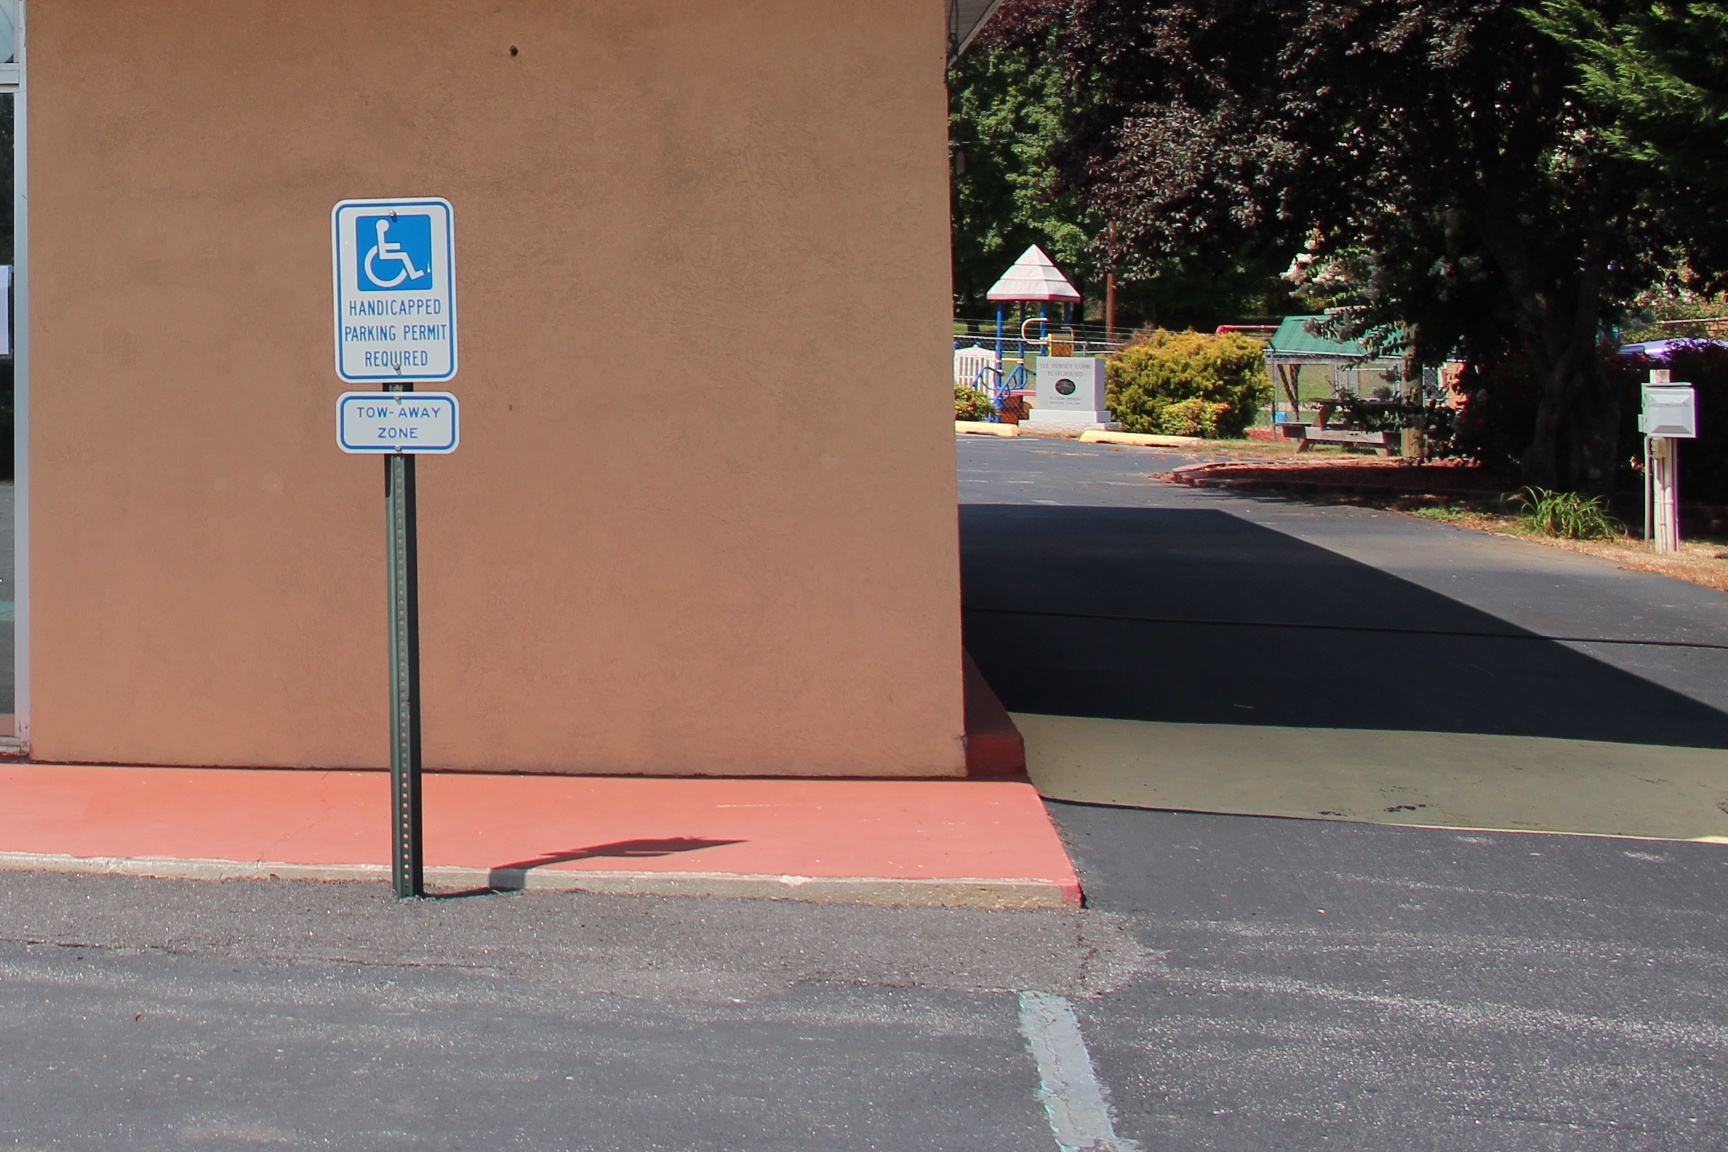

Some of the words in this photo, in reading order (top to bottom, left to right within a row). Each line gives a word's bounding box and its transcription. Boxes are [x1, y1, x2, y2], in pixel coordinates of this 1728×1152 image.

[349, 299, 441, 316] HANDICAPPED
[344, 325, 396, 342] PARKING
[403, 324, 447, 341] PERMIT
[364, 350, 428, 367] REQUIRED
[377, 427, 418, 438] ZONE
